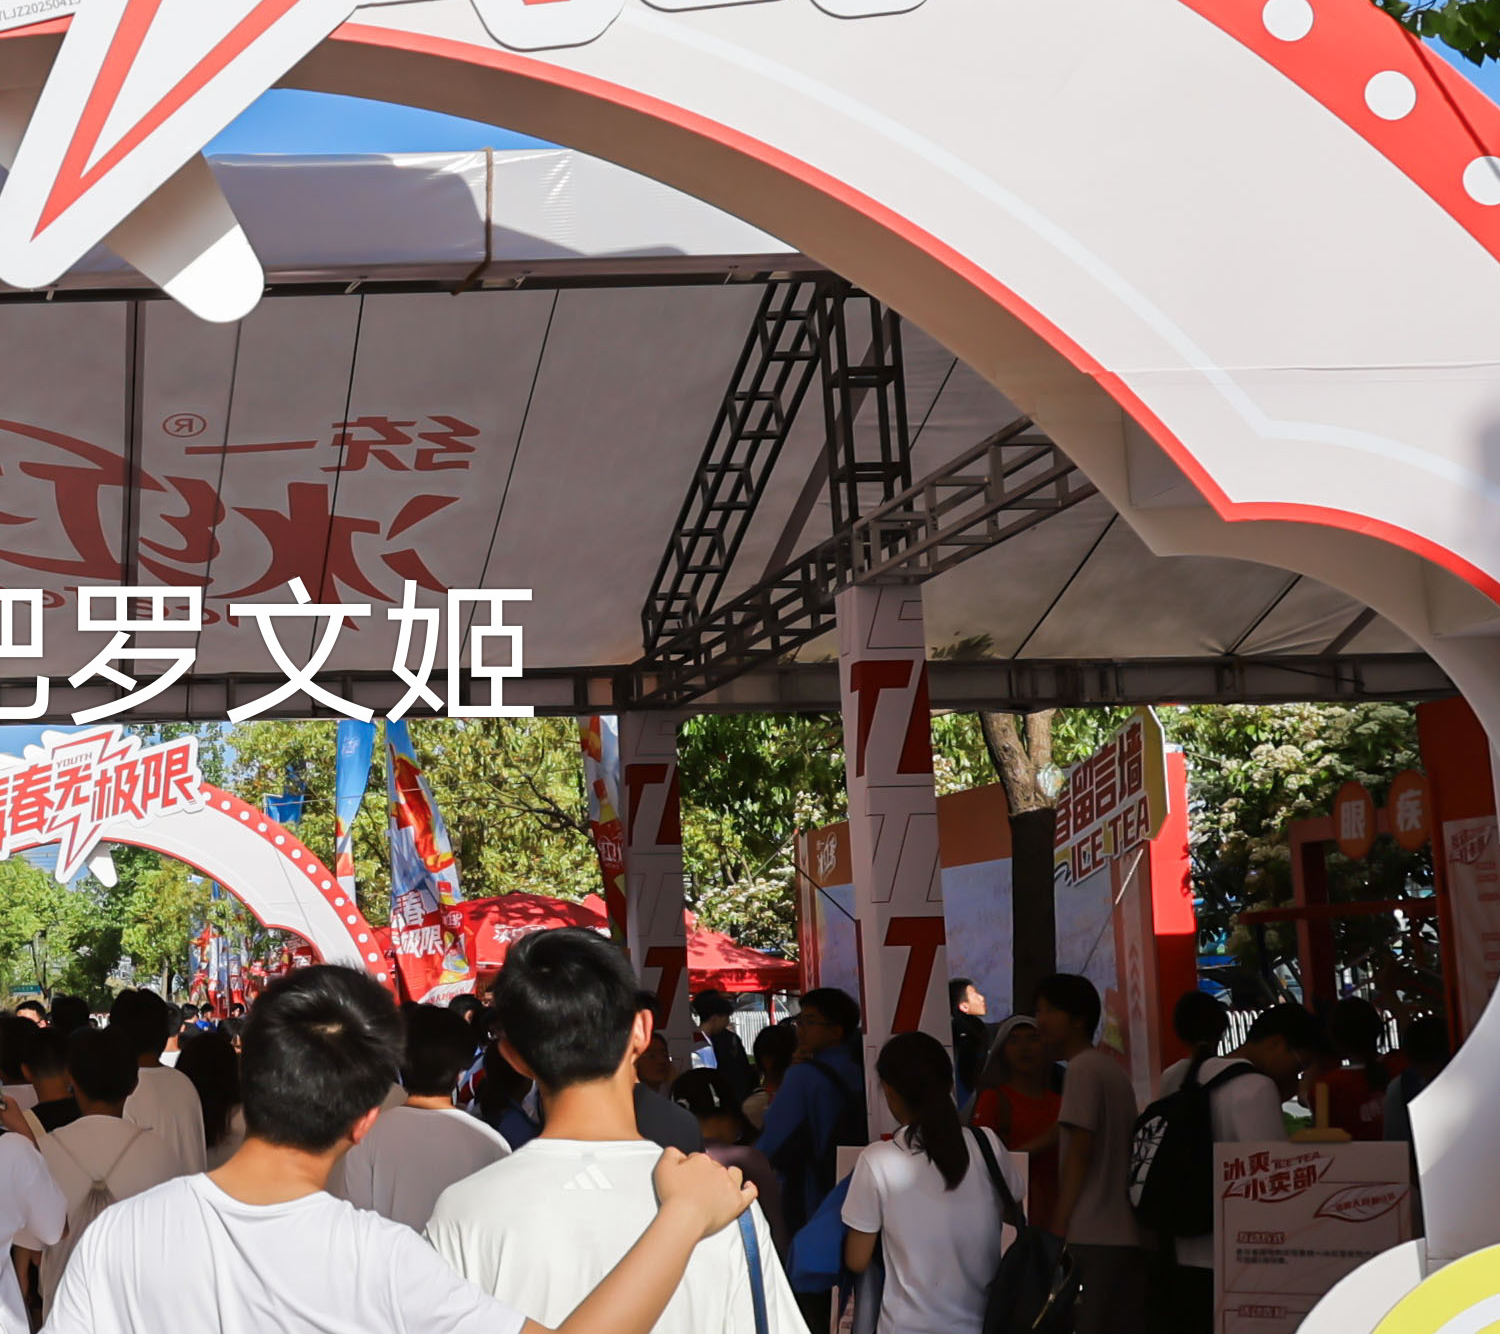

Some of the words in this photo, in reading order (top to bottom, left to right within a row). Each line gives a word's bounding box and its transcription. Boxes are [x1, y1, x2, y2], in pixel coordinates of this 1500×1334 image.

[55, 750, 93, 770] YOUTH
[1070, 827, 1104, 884] ICE
[1108, 794, 1150, 857] TEA
[1223, 1151, 1270, 1181] 冰爽
[1244, 1165, 1317, 1202] 小卖部
